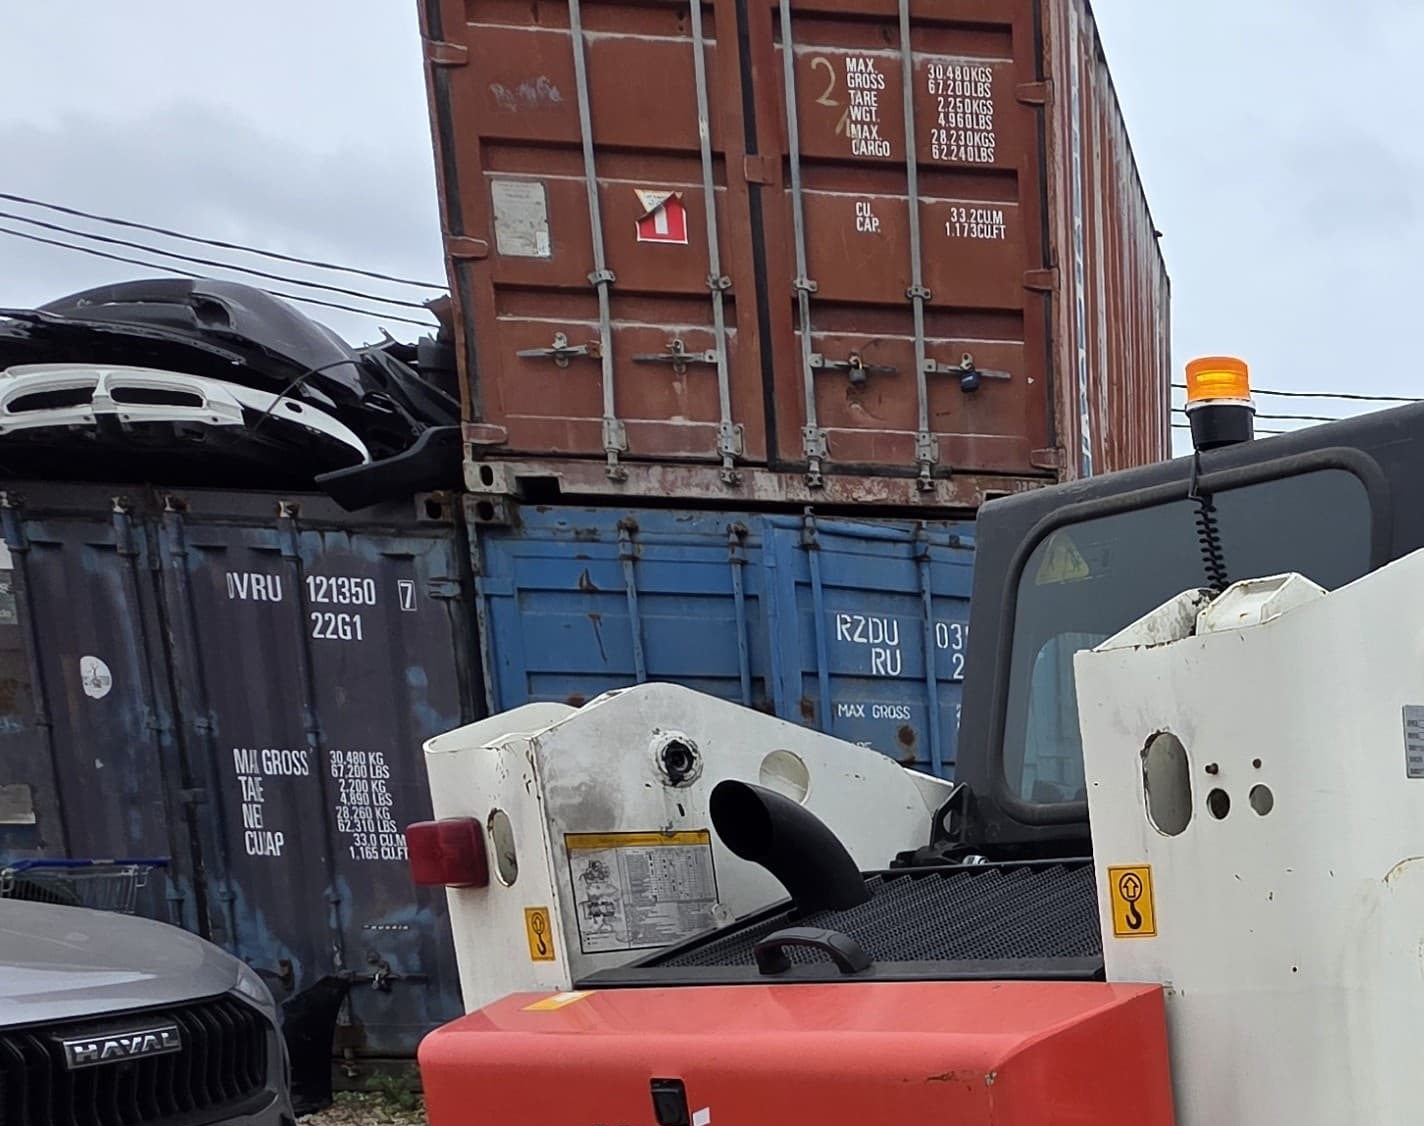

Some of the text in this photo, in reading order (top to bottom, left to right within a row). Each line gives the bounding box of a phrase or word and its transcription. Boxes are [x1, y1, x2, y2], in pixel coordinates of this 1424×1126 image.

[846, 58, 879, 74] MAX.
[928, 64, 992, 83] 30.480KGS
[811, 57, 839, 106] 2
[847, 73, 885, 89] GROSS
[928, 81, 991, 98] 67.200LBS
[848, 90, 878, 107] TARE
[938, 97, 993, 115] 2.250KGS
[850, 106, 880, 122] WGT.
[938, 113, 992, 130] 4.960LBS
[851, 124, 882, 141] MAX.
[931, 129, 995, 148] 28.230KGS
[852, 140, 890, 156] CARGO
[932, 145, 994, 163] 62.240LBS
[856, 202, 874, 217] CU.
[856, 217, 881, 232] CAP.
[306, 575, 376, 605] 121350
[400, 582, 412, 609] 7
[311, 612, 363, 641] 22G1
[836, 614, 969, 650] RZDU 03
[871, 648, 901, 676] RU
[838, 704, 911, 719] MAX GROSS
[233, 749, 309, 776] MA GROSS
[368, 751, 384, 766] KG
[369, 765, 390, 779] LBS
[237, 776, 265, 802] TAE
[371, 779, 386, 794] KG
[372, 793, 393, 806] LBS
[375, 807, 391, 820] KG
[377, 820, 397, 833] LBS
[74, 1032, 178, 1062] HAVAL
